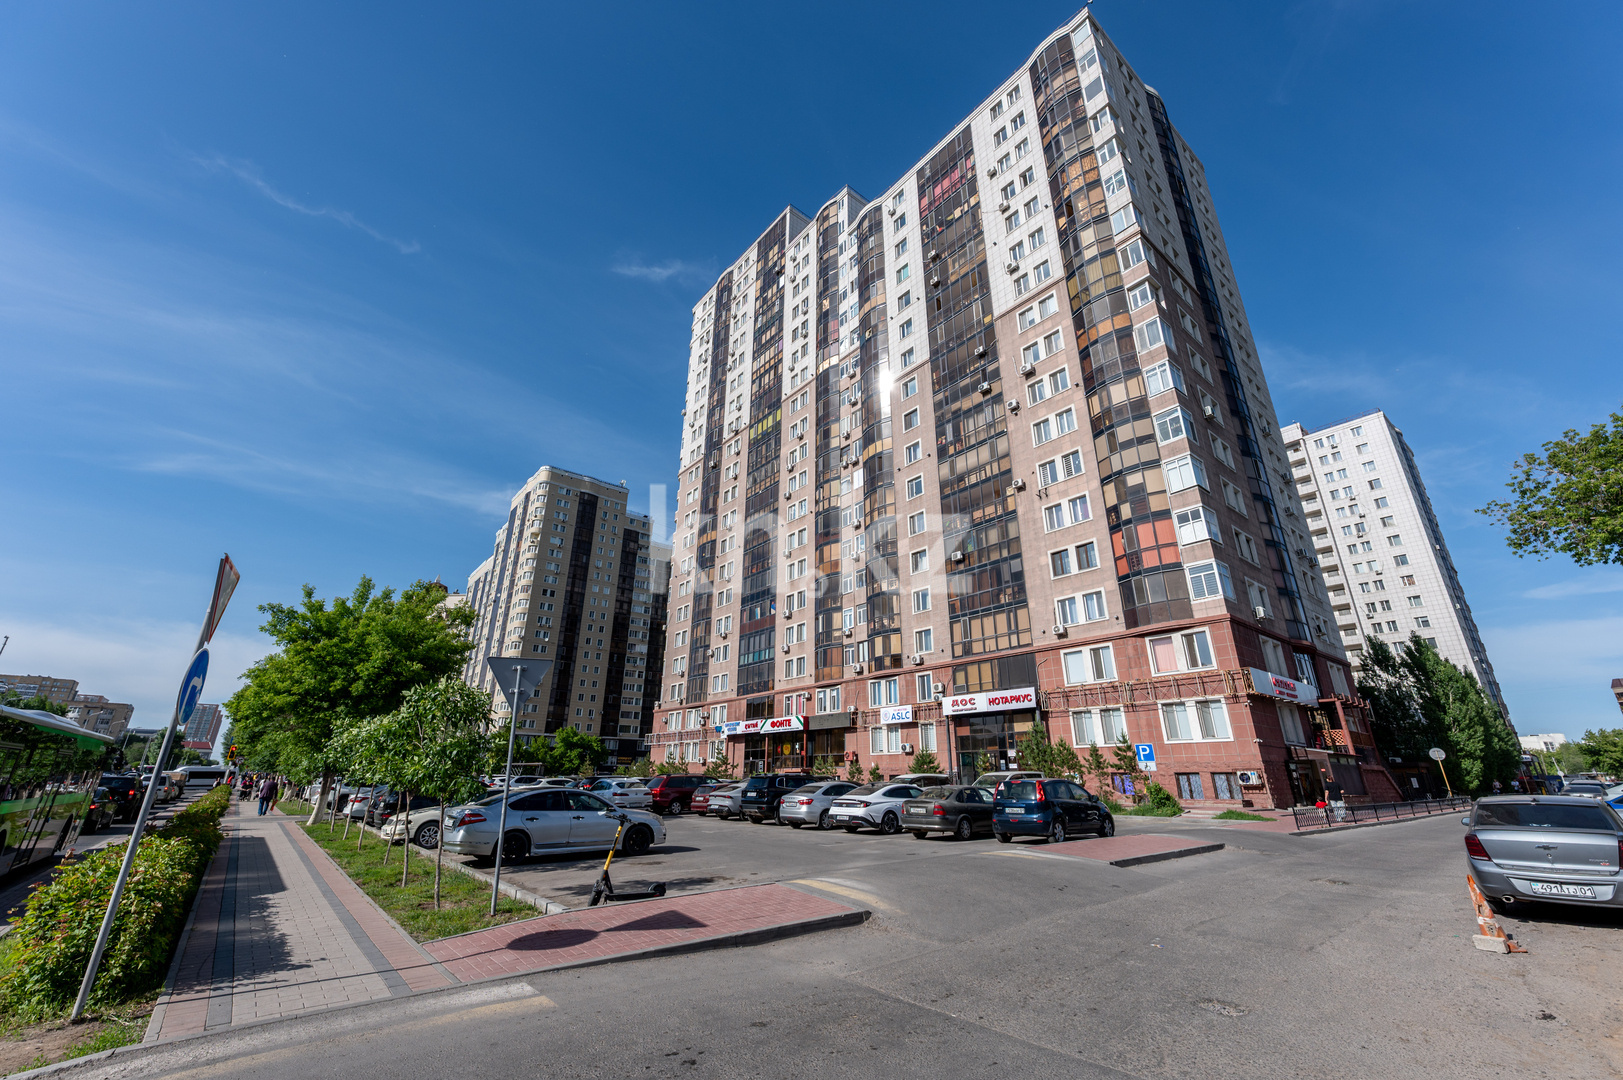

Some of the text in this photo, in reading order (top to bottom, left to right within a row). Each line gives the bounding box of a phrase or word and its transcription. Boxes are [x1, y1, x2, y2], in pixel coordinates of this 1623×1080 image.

[951, 697, 977, 707] ДОС
[988, 692, 1033, 706] НОТАРИУС
[891, 711, 910, 721] ASLC
[770, 718, 792, 728] ФОНТЕ
[1138, 745, 1150, 761] P
